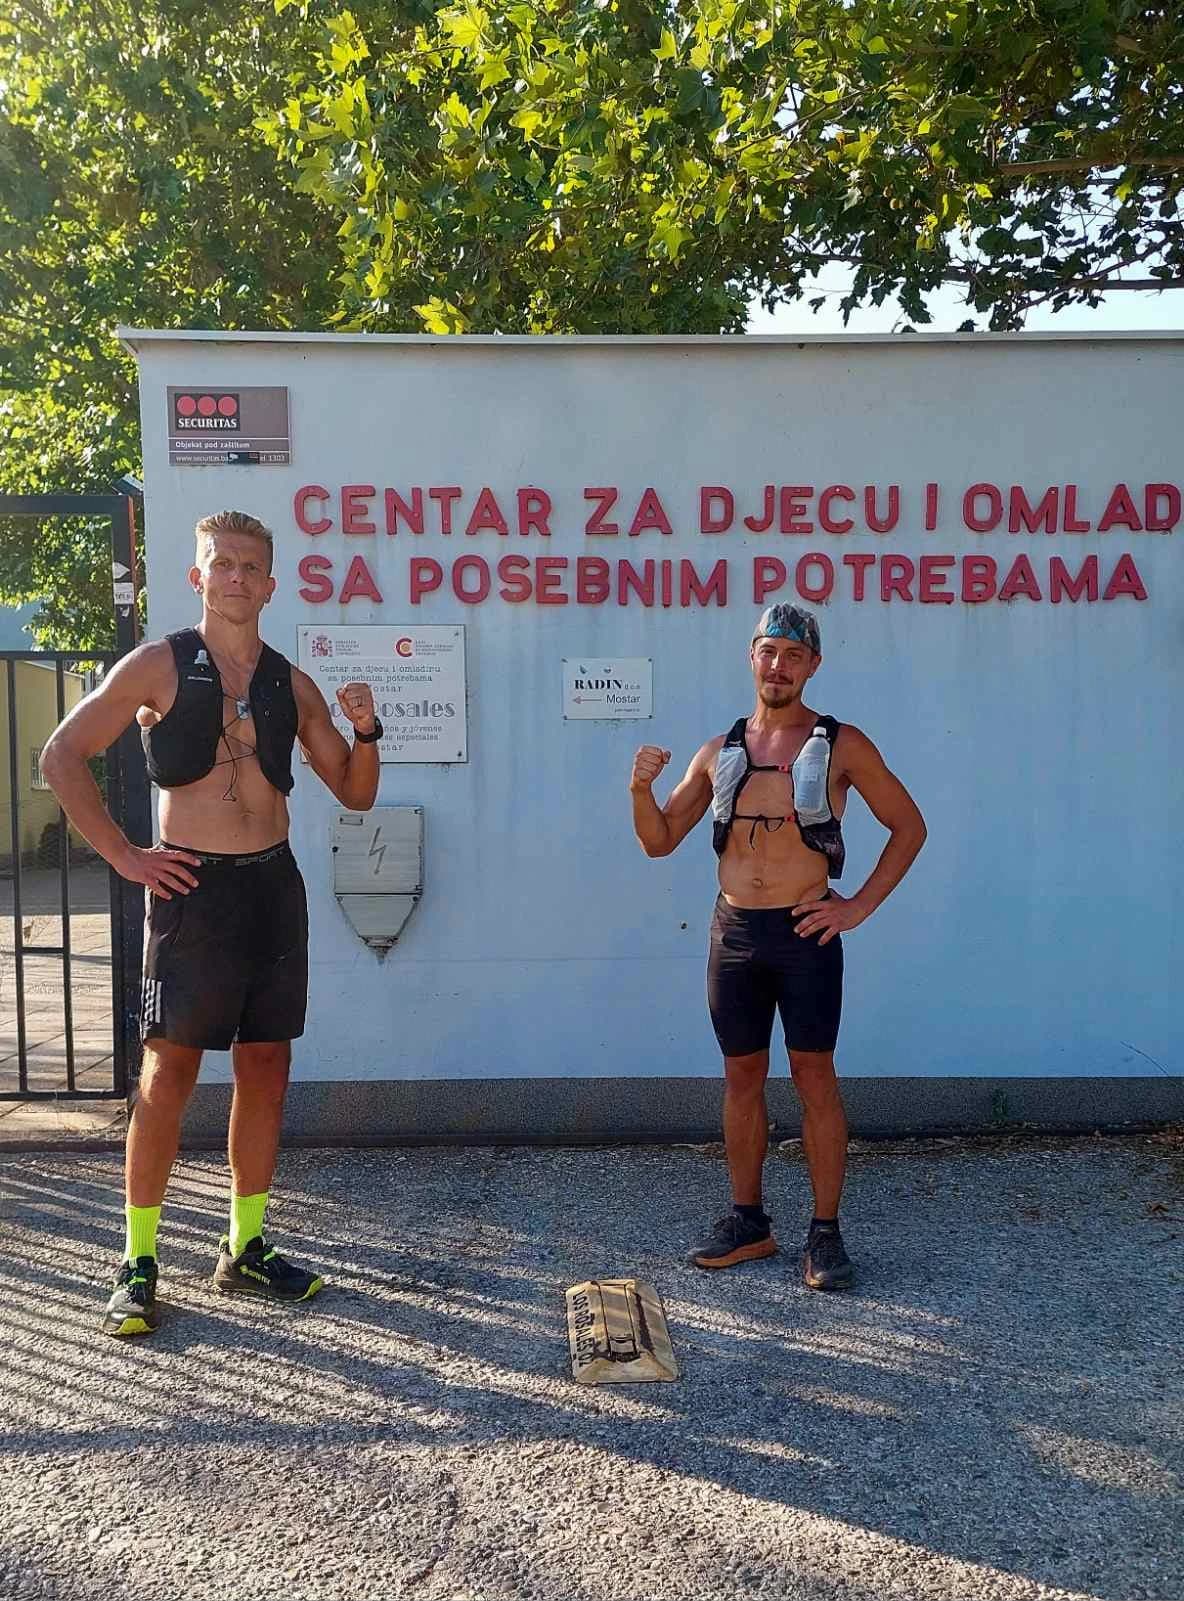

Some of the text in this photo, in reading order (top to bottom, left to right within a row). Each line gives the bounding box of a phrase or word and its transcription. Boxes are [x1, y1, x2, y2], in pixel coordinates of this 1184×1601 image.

[177, 418, 237, 428] SECURITAS
[175, 441, 203, 450] Objekat
[204, 441, 218, 450] pod
[293, 482, 1182, 537] CENTAR ZA DJECU I OMLAD
[298, 552, 1148, 608] SA POSEBNIM POTREBAMA
[319, 664, 349, 673] Centar
[365, 664, 389, 674] djecu
[341, 673, 383, 684] posebnim
[386, 673, 432, 684] potrebama
[370, 685, 403, 693] ostar
[574, 679, 622, 690] RADIN
[606, 694, 641, 705] Mostar
[375, 699, 456, 718] osales
[572, 1289, 589, 1311] LOS
[574, 1309, 594, 1352] ROSALES
